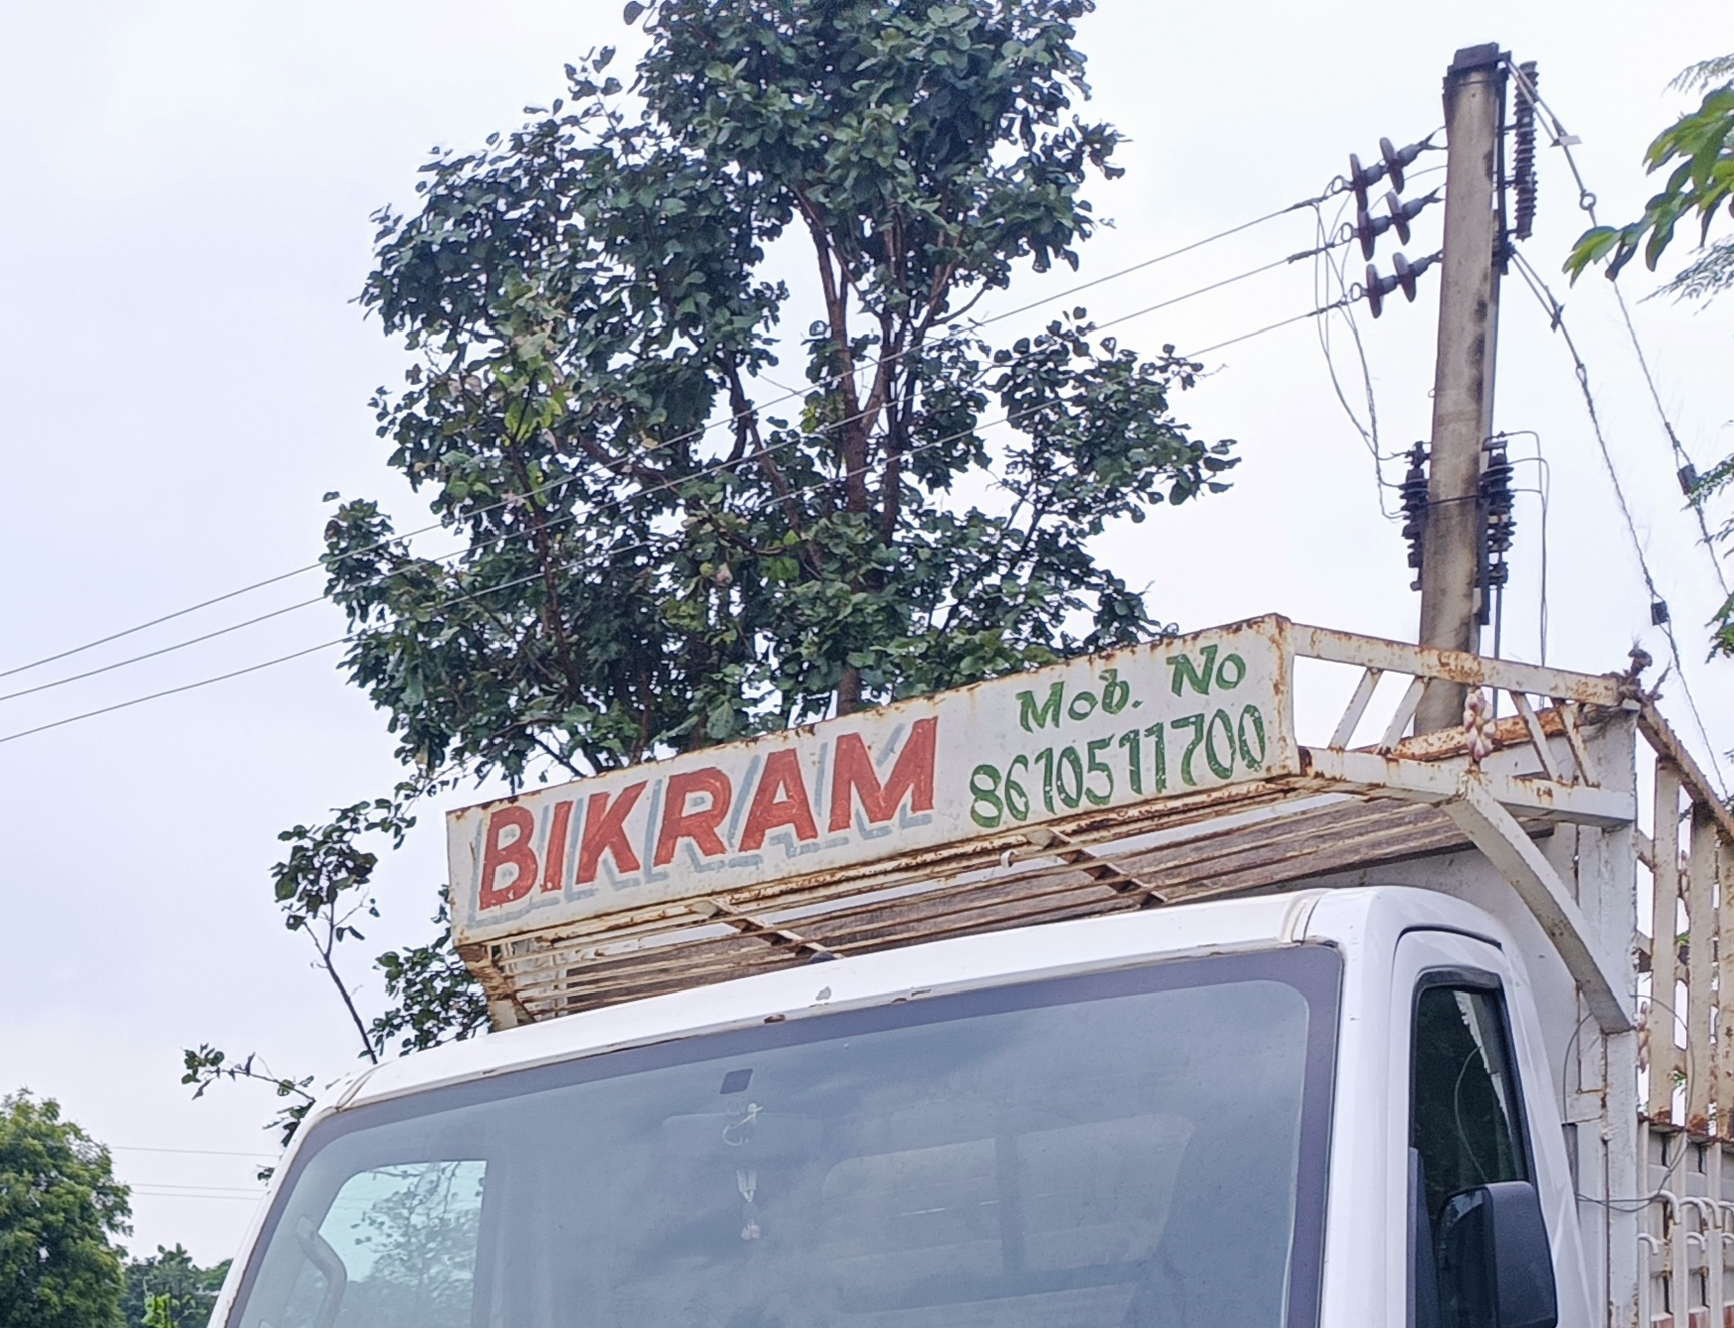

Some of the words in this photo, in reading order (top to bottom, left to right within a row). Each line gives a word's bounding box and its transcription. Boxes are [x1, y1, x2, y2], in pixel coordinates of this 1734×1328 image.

[1016, 668, 1143, 733] Mob.
[1166, 644, 1246, 697] No
[477, 716, 938, 911] BIKRAM
